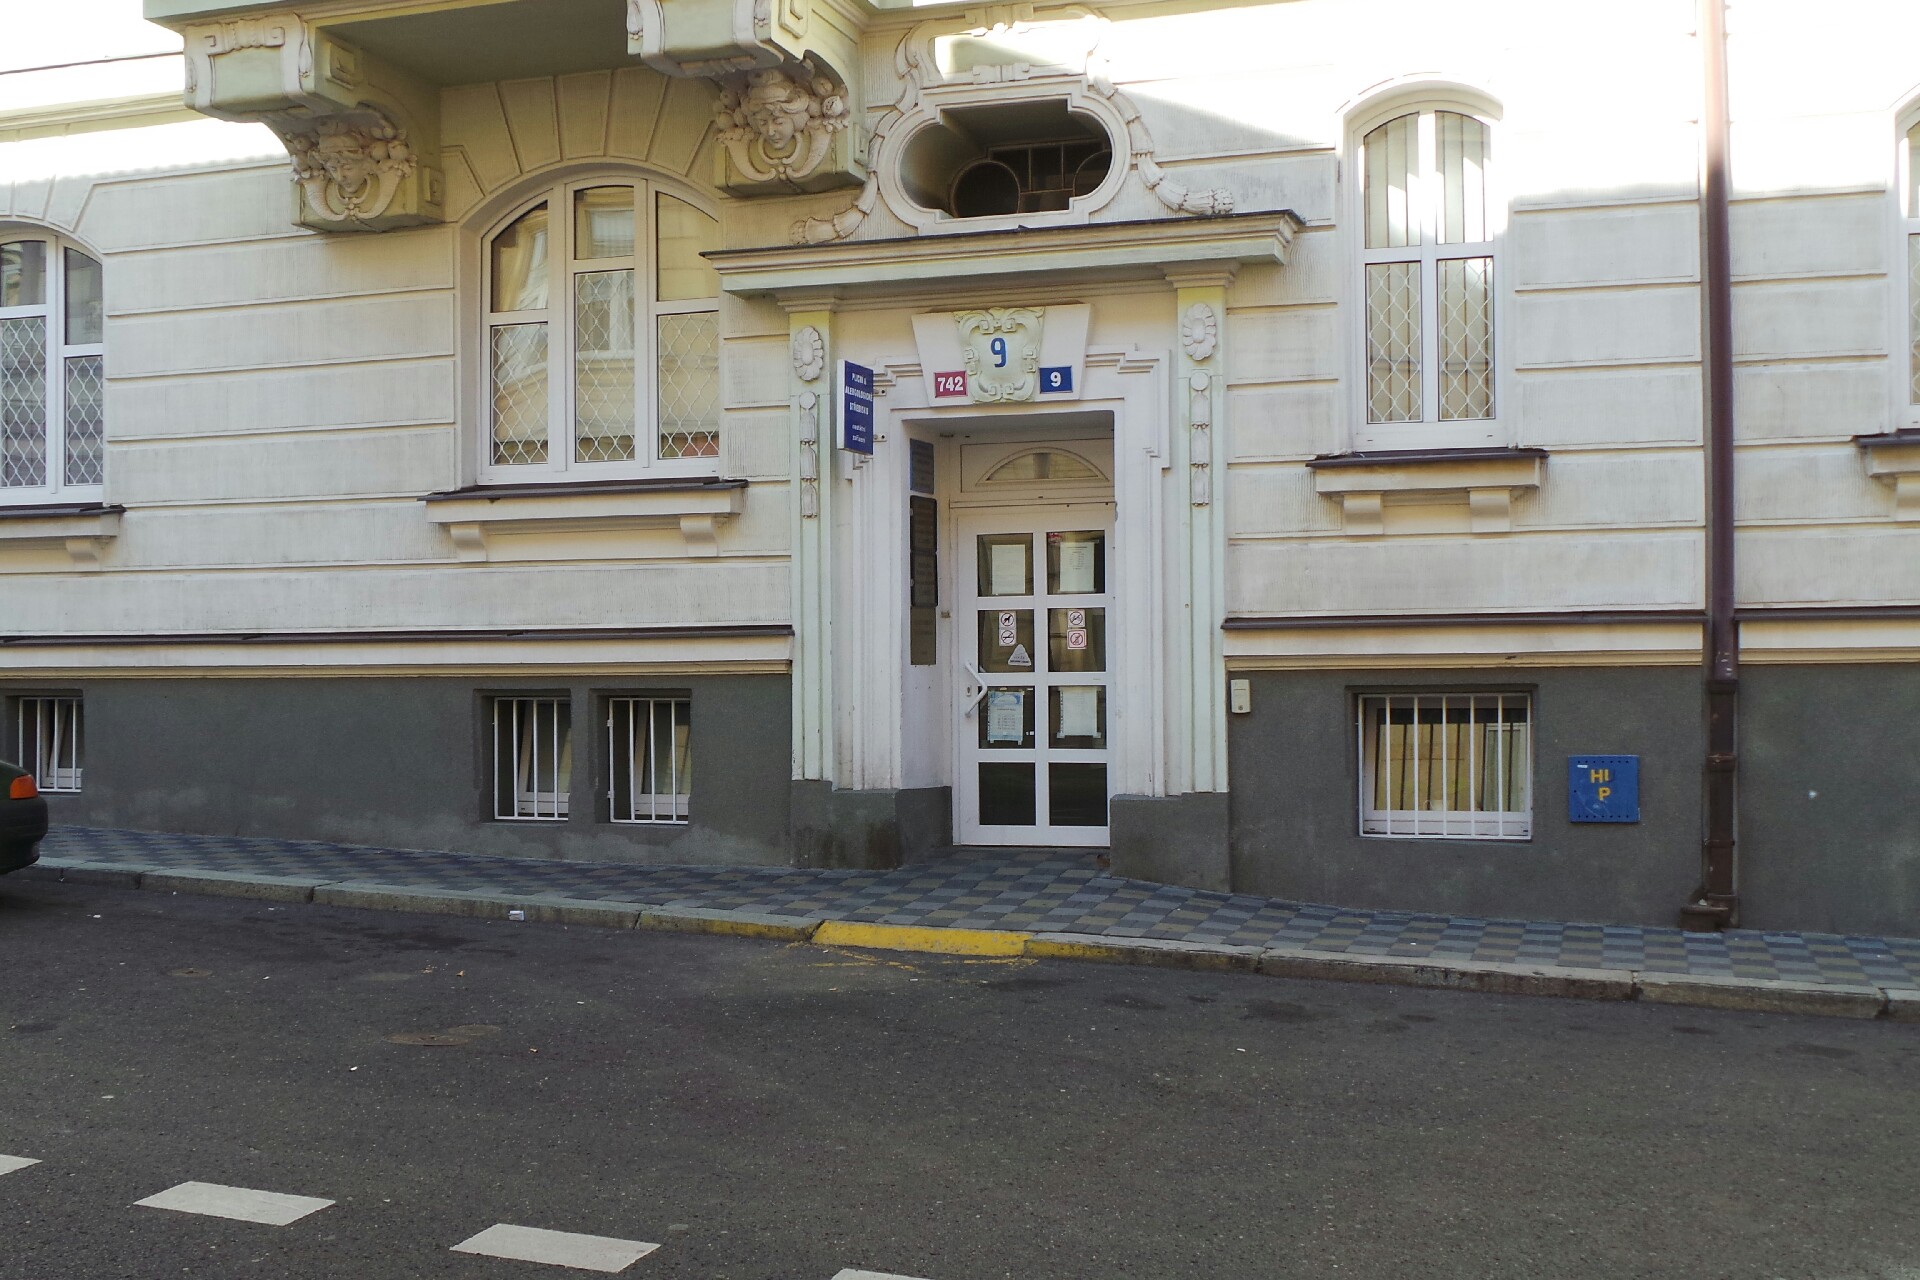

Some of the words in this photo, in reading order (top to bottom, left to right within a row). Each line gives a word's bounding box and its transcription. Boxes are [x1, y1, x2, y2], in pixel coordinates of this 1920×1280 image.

[991, 338, 1006, 367] 9
[937, 376, 964, 392] 742
[1050, 371, 1062, 387] 9
[1598, 787, 1611, 801] P
